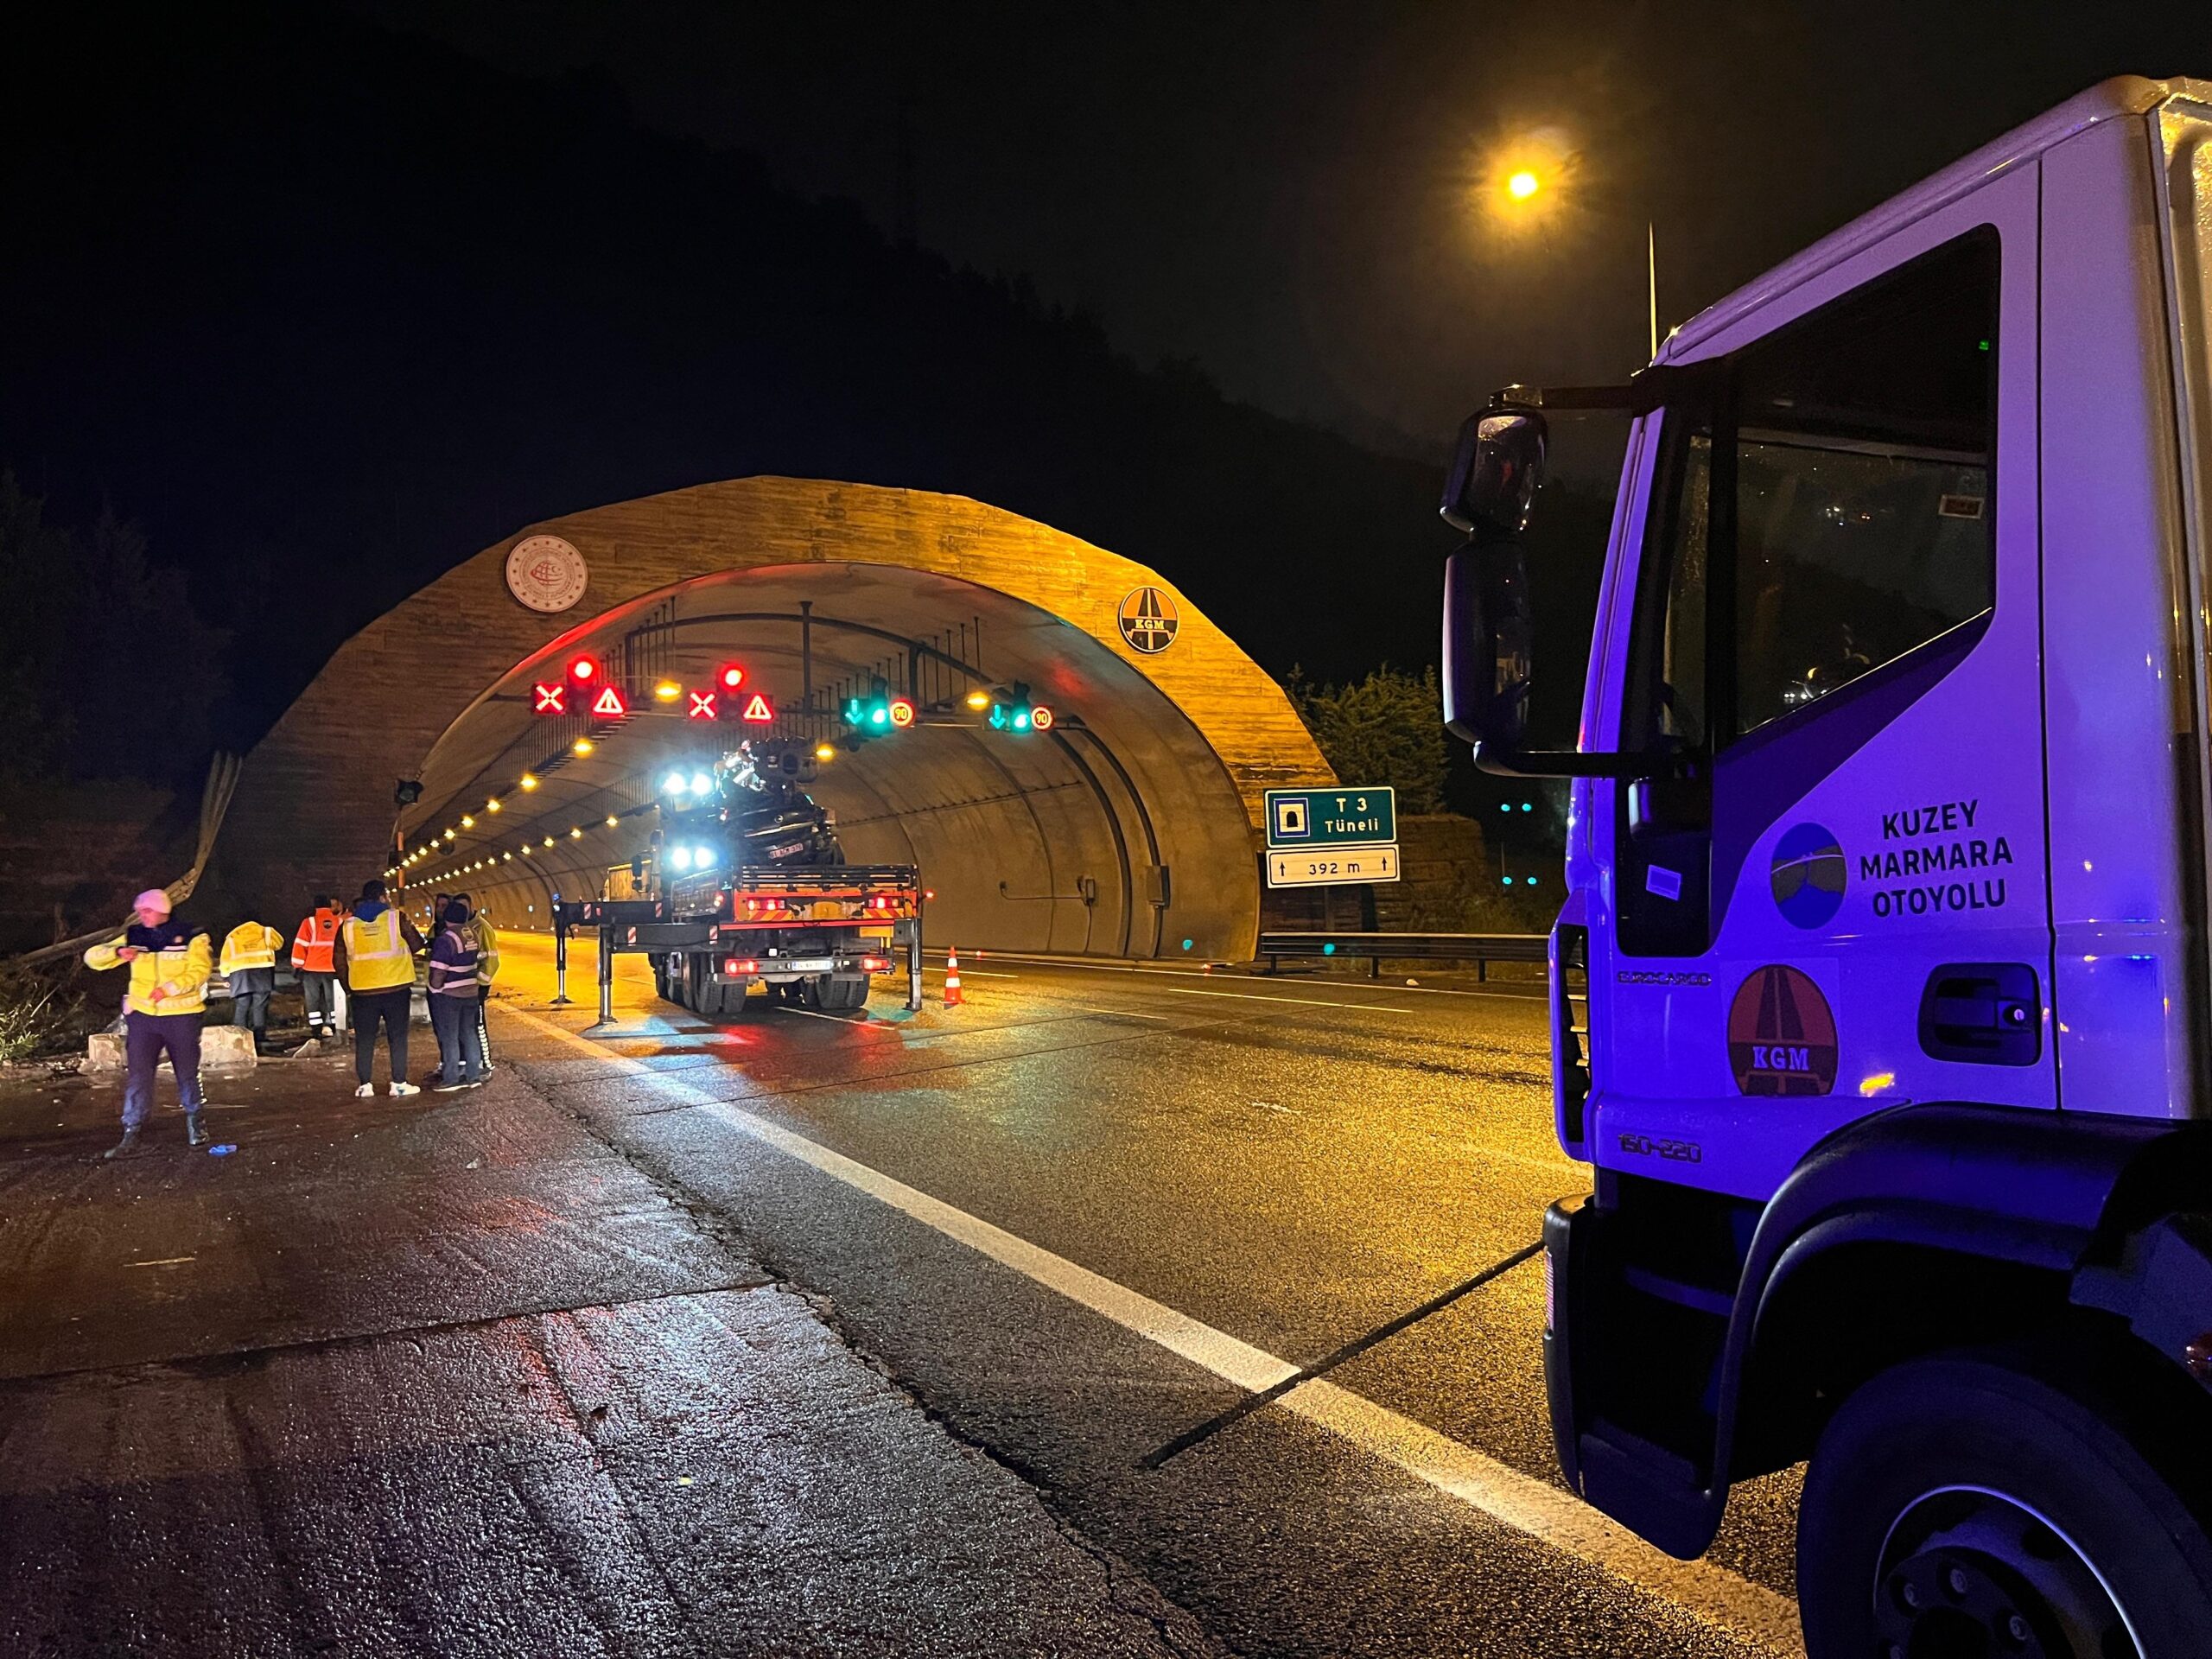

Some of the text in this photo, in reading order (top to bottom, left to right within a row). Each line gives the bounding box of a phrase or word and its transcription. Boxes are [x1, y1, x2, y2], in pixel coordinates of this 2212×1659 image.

[1135, 619, 1165, 630] KGM
[1036, 713, 1047, 724] 90
[1336, 797, 1368, 813] T 3
[1325, 817, 1379, 834] Tüneli
[1882, 799, 1979, 840] KUZEY
[1859, 836, 2013, 881] MARMARA
[1308, 862, 1360, 875] 392 m
[1872, 878, 2005, 918] OTOYOLU
[1752, 1046, 1809, 1071] KGM
